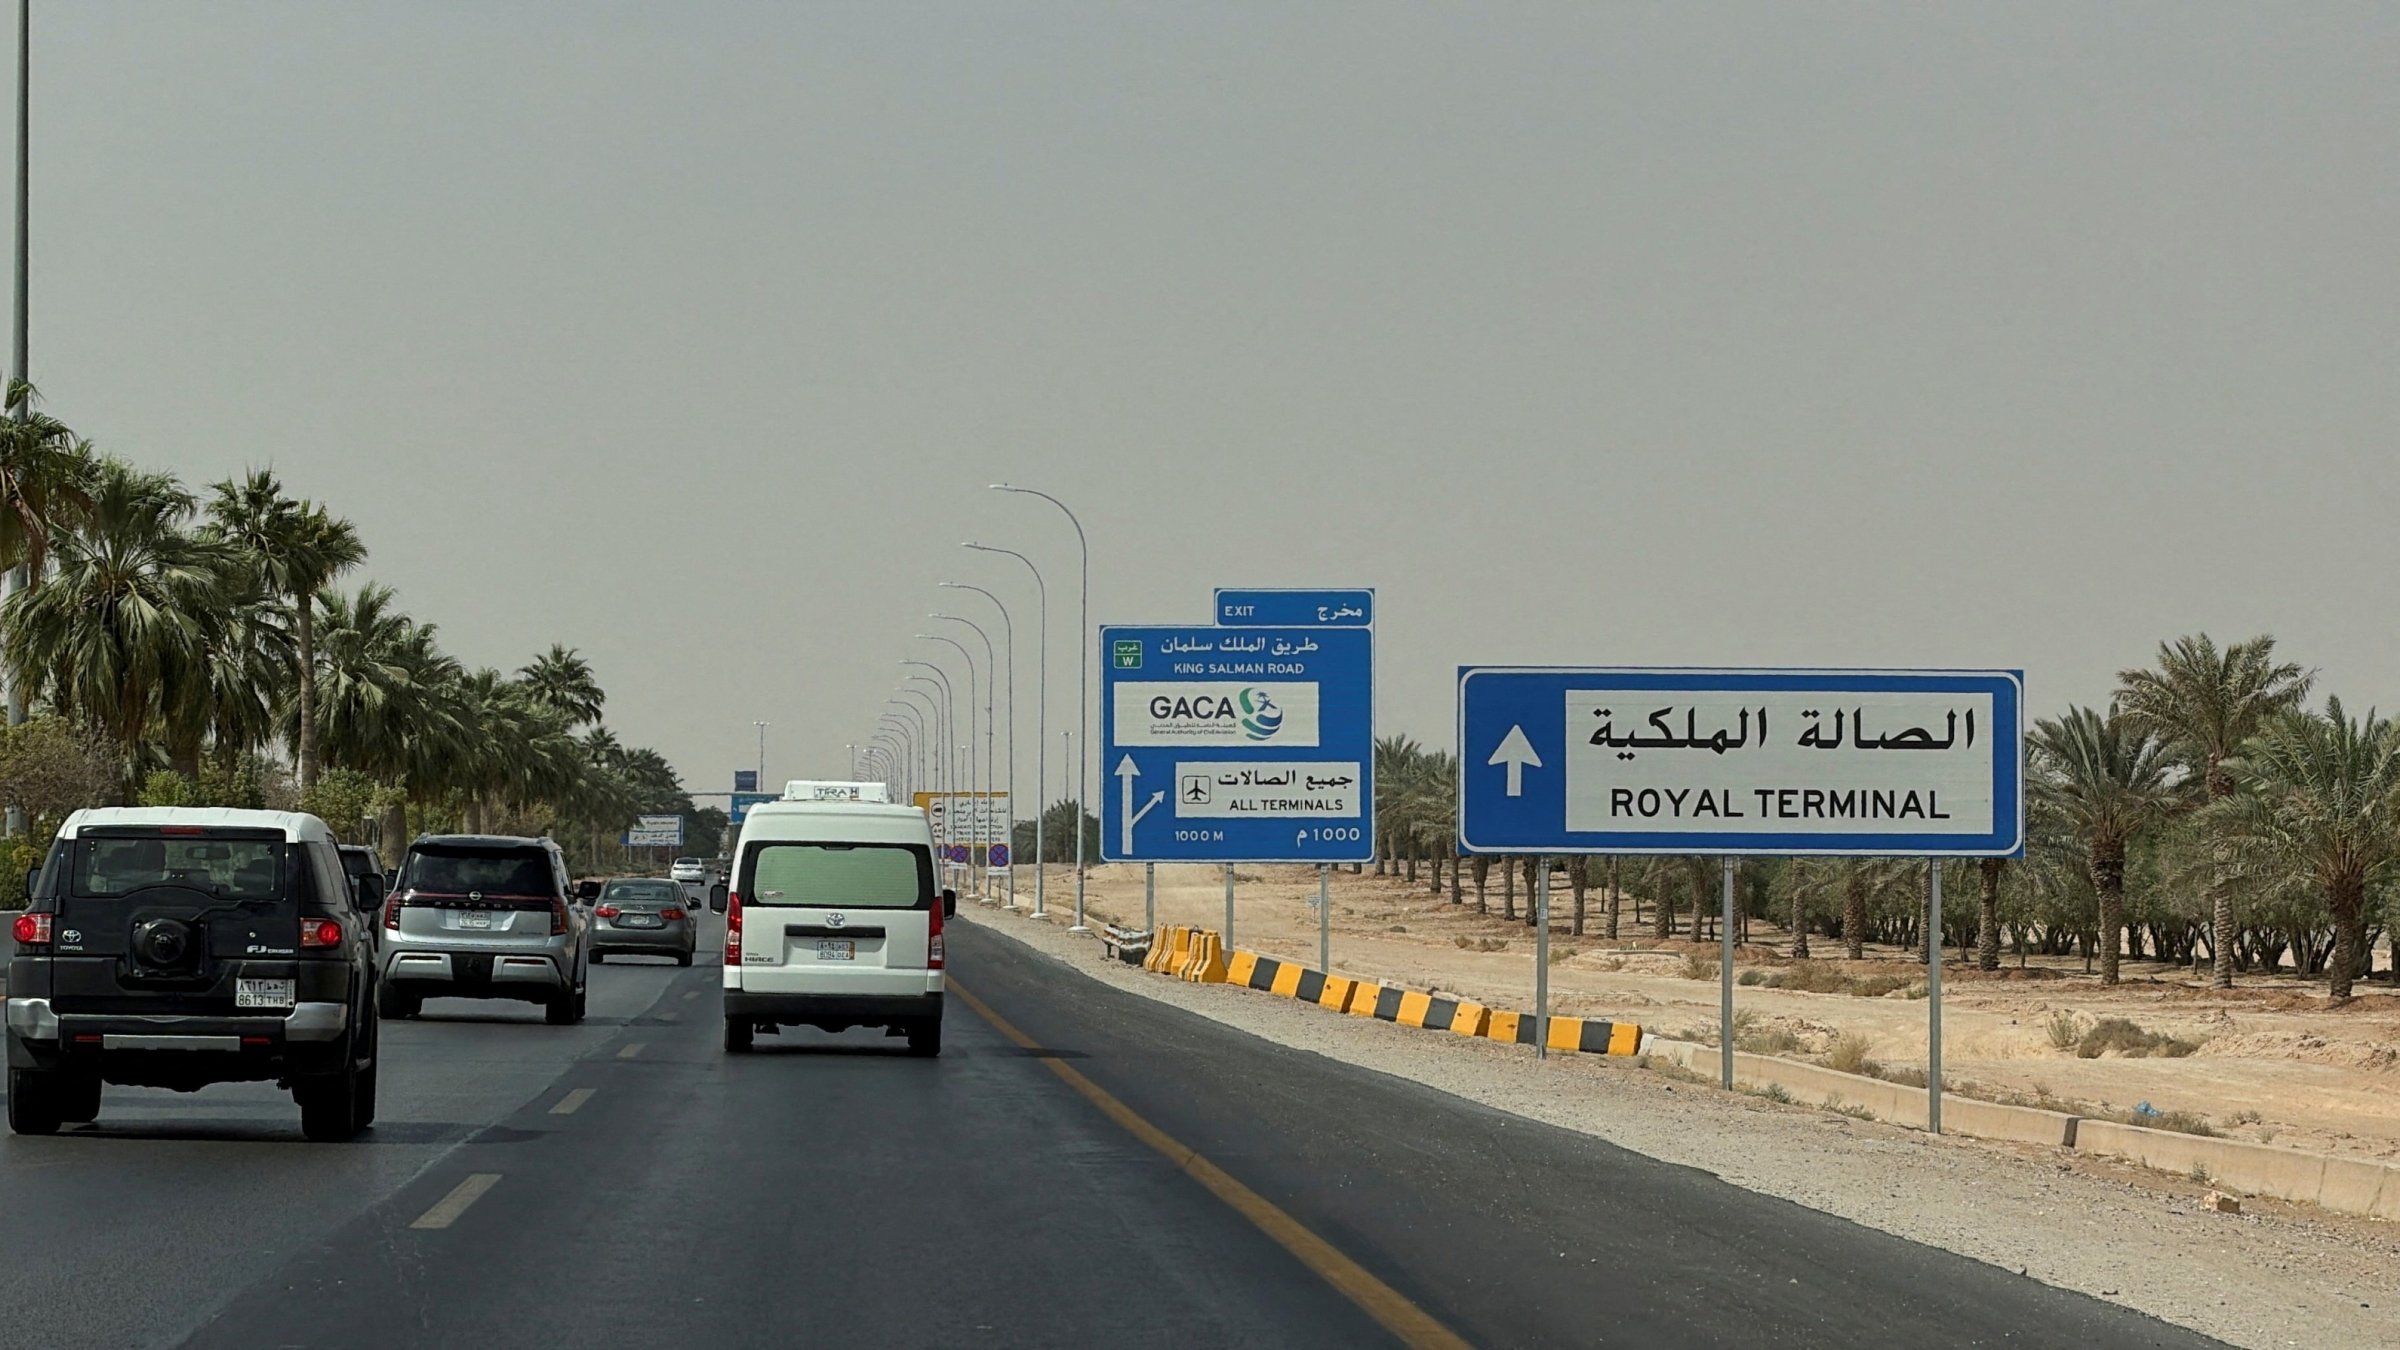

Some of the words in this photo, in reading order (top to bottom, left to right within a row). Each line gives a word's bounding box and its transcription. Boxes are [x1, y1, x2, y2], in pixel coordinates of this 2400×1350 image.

[1224, 605, 1255, 617] EXIT
[1317, 602, 1363, 621] مخرج
[1160, 636, 1213, 654] سلمان
[1218, 636, 1266, 653] الملك
[1271, 636, 1319, 656] طريق
[1122, 656, 1134, 667] W
[1174, 663, 1204, 674] KING
[1208, 663, 1264, 674] SALMAN
[1267, 663, 1304, 674] ROAD
[1149, 695, 1237, 719] GACA
[1588, 705, 1768, 762] الملكية
[1796, 706, 1975, 751] الصالة
[1217, 769, 1297, 786] الصالات
[1305, 774, 1353, 791] جميع
[1229, 799, 1258, 811] ALL
[1261, 799, 1344, 811] TERMINALS
[1610, 788, 1745, 818] ROYAL
[1754, 789, 1951, 819] TERMINAL
[1175, 830, 1209, 841] 1000
[1213, 830, 1224, 841] M
[1296, 829, 1308, 848] م
[1312, 827, 1361, 841] 1000
[246, 945, 267, 953] FJ
[238, 994, 264, 1006] 8613
